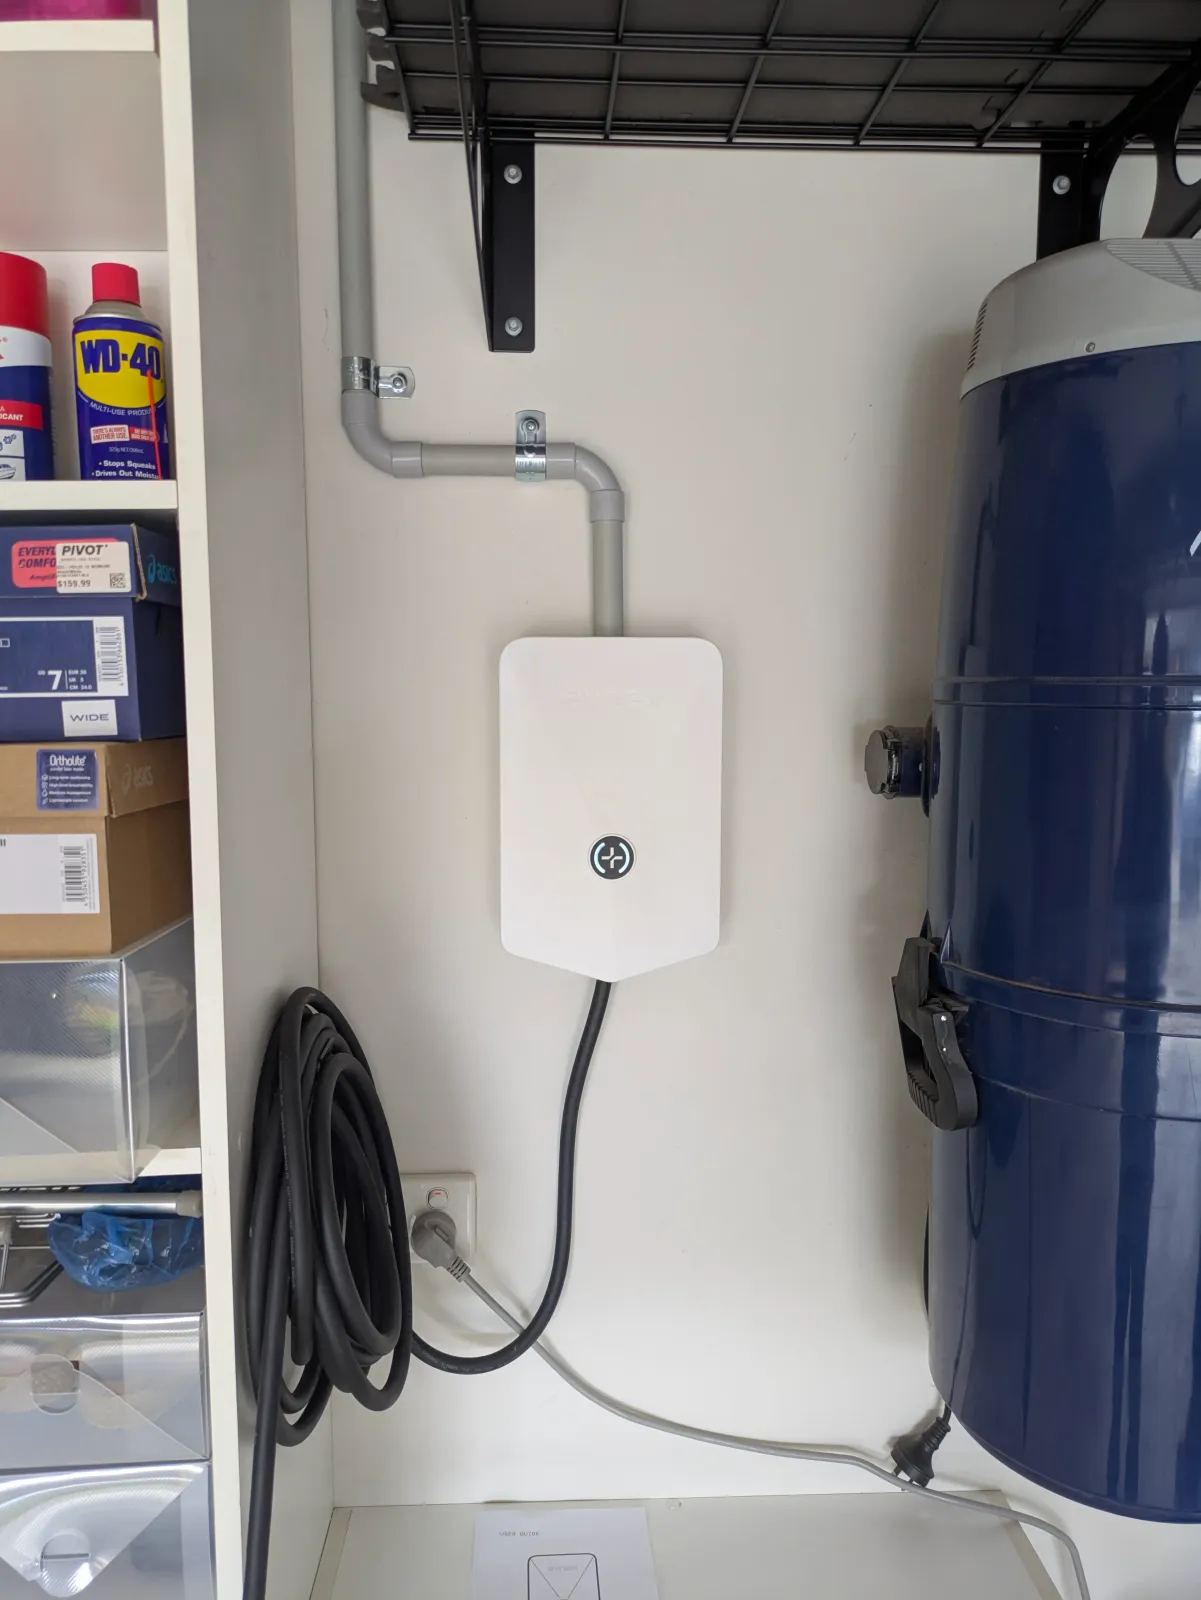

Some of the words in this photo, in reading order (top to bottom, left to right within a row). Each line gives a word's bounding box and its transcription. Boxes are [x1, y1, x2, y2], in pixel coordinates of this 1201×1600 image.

[80, 339, 161, 380] WD-40
[90, 401, 126, 416] MULTI-USE
[103, 460, 125, 468] Stops
[127, 460, 156, 470] Squeaks
[61, 544, 104, 556] PIVOT
[57, 579, 91, 588] $159.99
[47, 669, 63, 691] 7
[70, 713, 109, 722] WIDE
